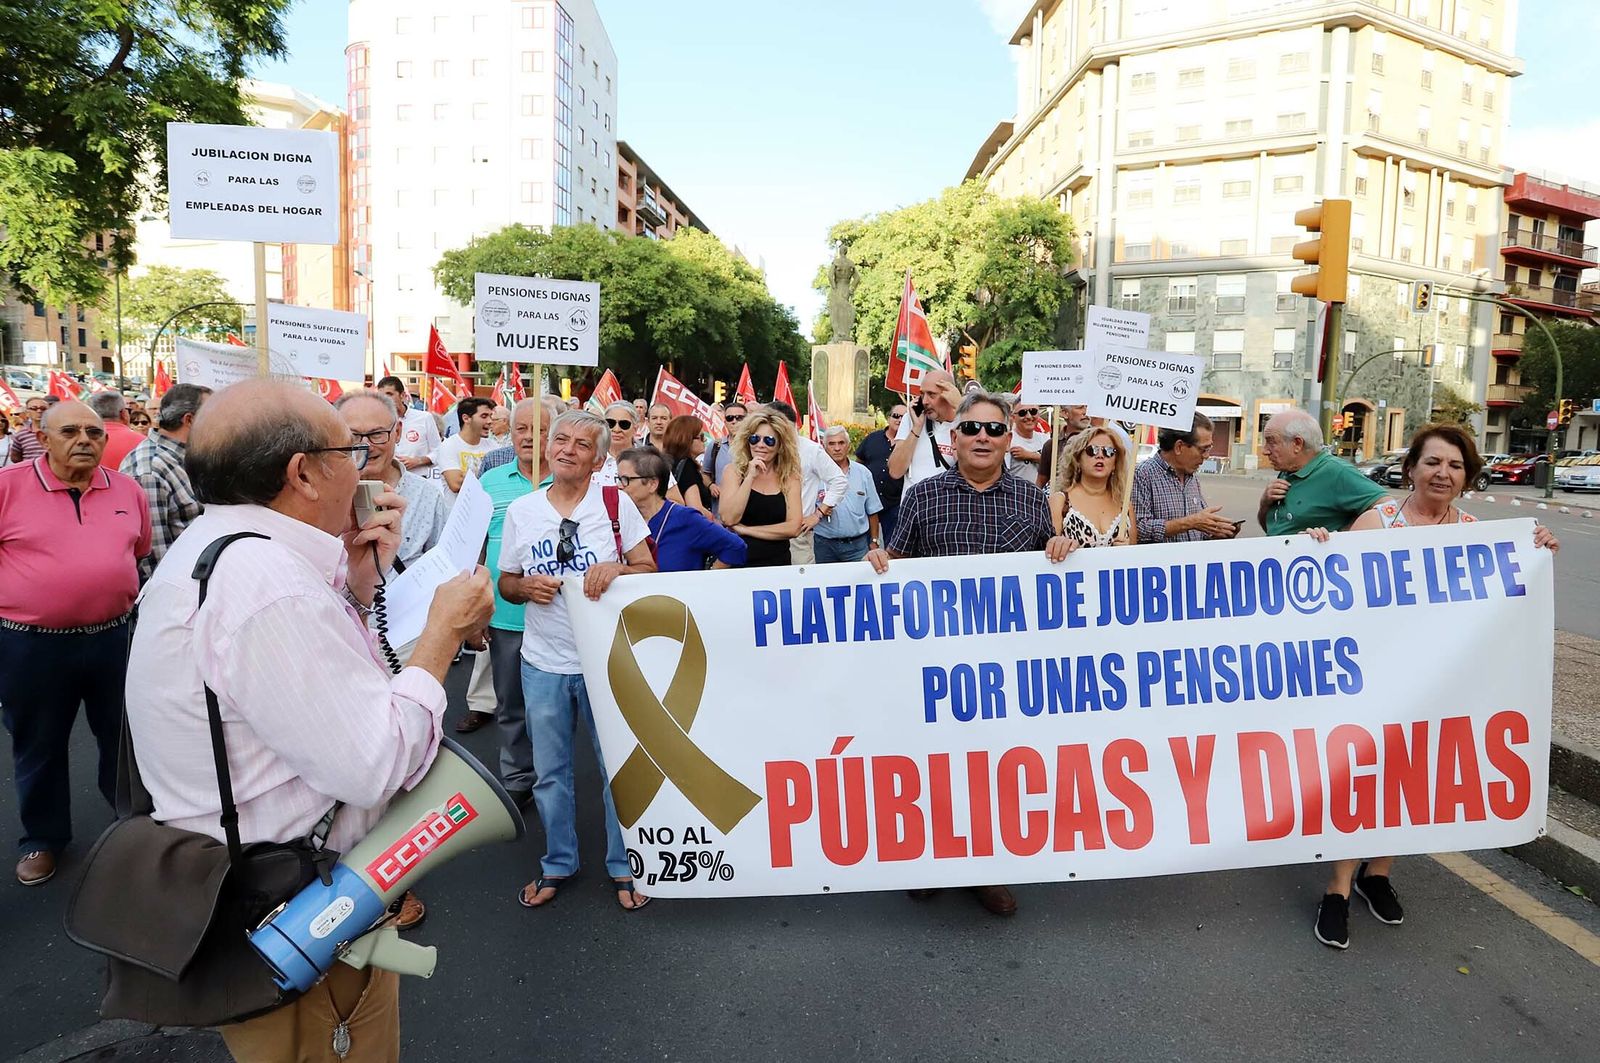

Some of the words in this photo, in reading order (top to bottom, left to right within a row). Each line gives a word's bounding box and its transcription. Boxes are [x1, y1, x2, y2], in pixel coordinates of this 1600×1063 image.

[191, 147, 269, 161] JUBILACION
[273, 152, 312, 164] DIGNA
[228, 175, 256, 185] PARA
[259, 177, 280, 186] LAS
[185, 201, 255, 213] EMPLEADAS
[258, 205, 279, 214] DEL
[283, 206, 322, 216] HOGAR
[488, 285, 548, 299] PENSIONES
[550, 291, 591, 303] DIGNAS
[517, 310, 542, 320] PARA
[544, 312, 560, 321] LAS
[270, 318, 312, 329] PENSIONES
[313, 324, 359, 336] SUFICIENTES
[282, 332, 302, 341] PARA
[319, 337, 346, 346] VIUDAS
[496, 332, 579, 352] MUJERES
[1105, 353, 1157, 369] PENSIONES
[1158, 361, 1195, 375] DIGNAS
[1127, 376, 1149, 386] PARA
[1149, 379, 1164, 388] LAS
[1105, 393, 1178, 417] MUJERES
[531, 538, 554, 561] NO
[752, 575, 1027, 647] PLATAFORMA
[1036, 571, 1087, 630] DE
[1096, 553, 1355, 628] JUBILADO@S
[1360, 549, 1417, 610] DE
[1423, 541, 1527, 605] LEPE
[922, 661, 1007, 723] POR
[1015, 652, 1127, 717] UNAS
[1136, 636, 1364, 709] PENSIONES
[764, 735, 1154, 868] PÚBLICAS
[1167, 734, 1216, 845] Y
[1236, 710, 1532, 842] DIGNAS
[638, 826, 674, 845] NO
[682, 826, 713, 845] AL
[376, 814, 453, 883] CCOO
[626, 848, 734, 885] 0,25%
